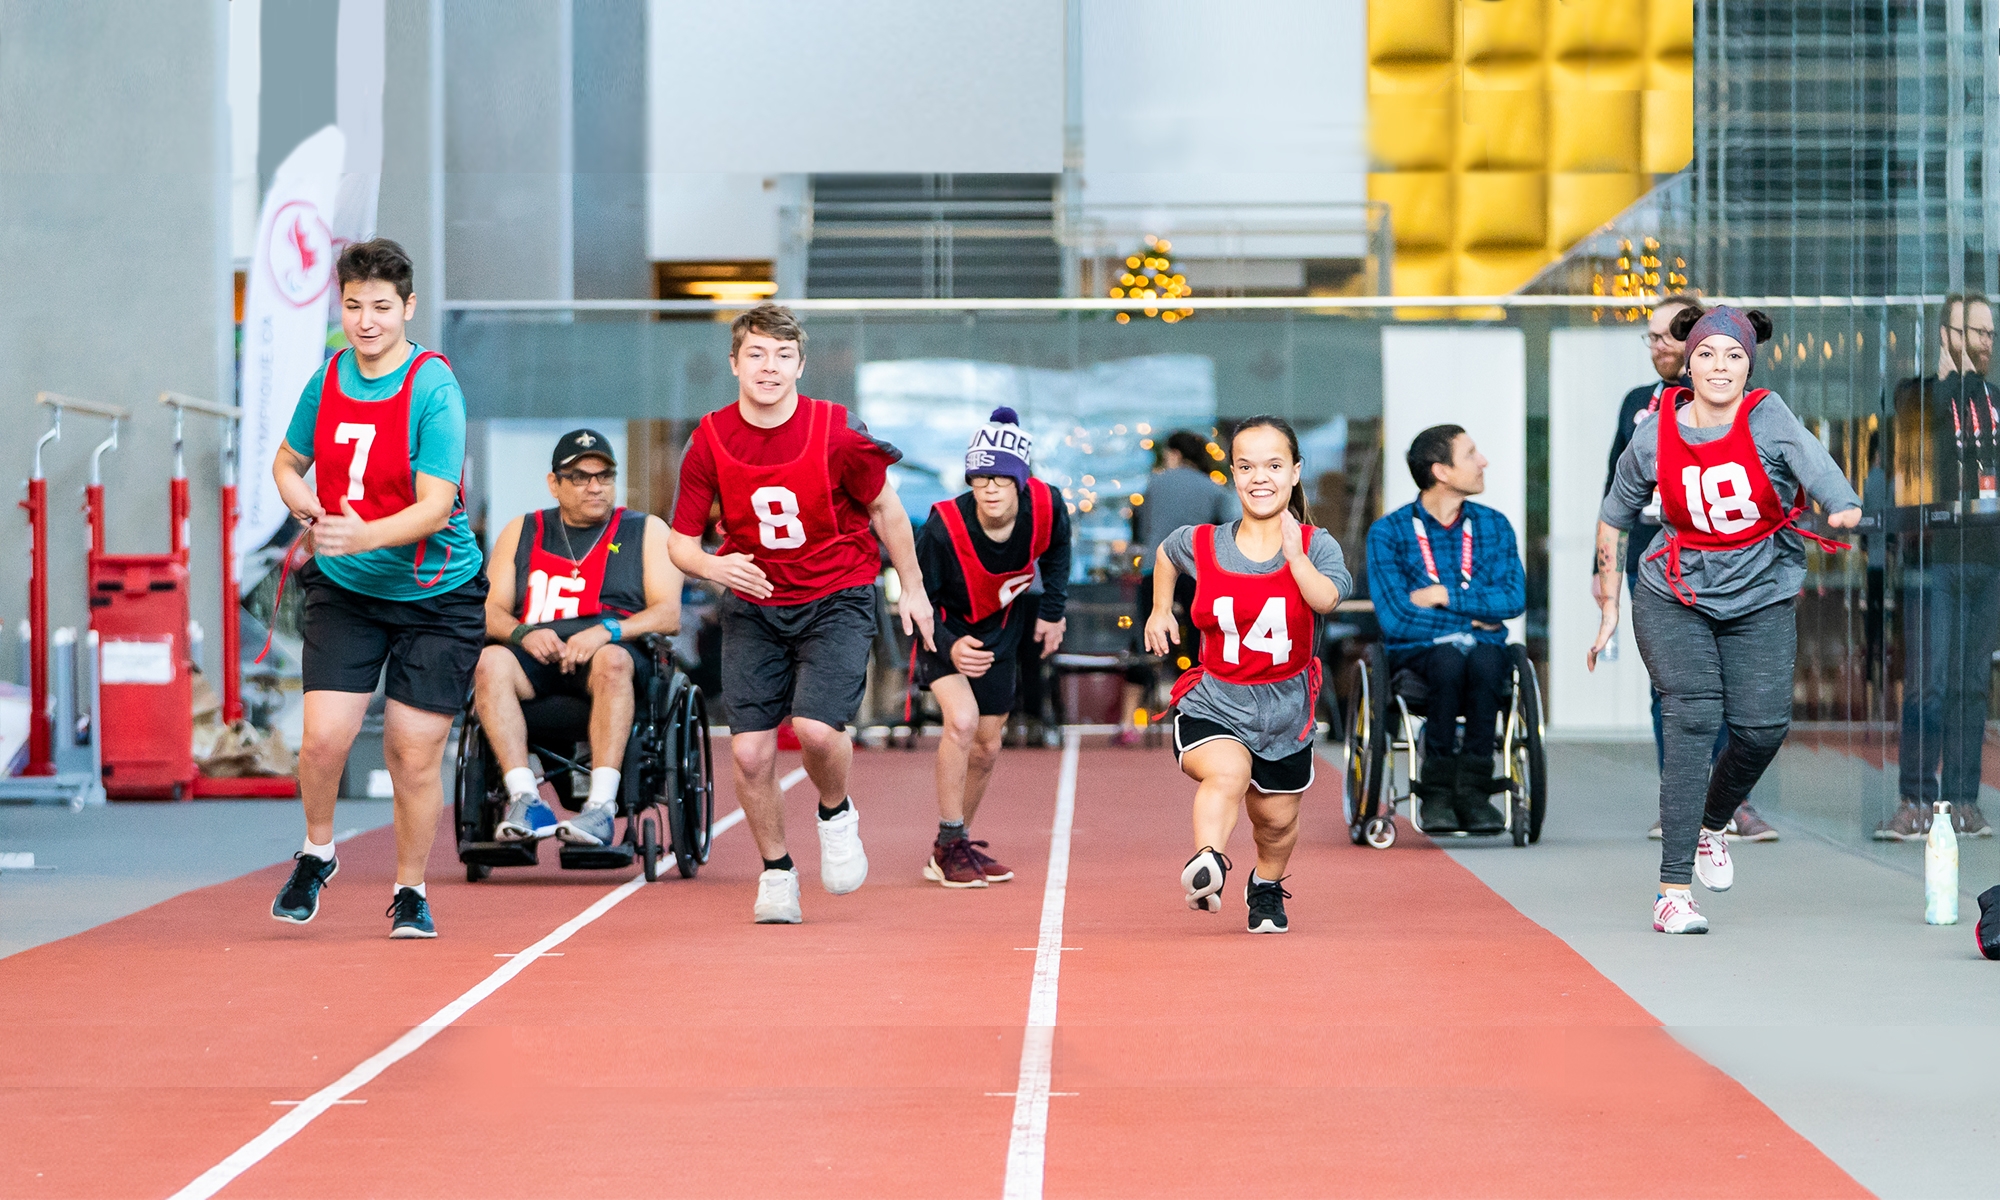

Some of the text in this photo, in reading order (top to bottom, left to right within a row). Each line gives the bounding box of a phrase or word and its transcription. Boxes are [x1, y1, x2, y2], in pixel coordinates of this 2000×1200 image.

[334, 422, 377, 501] 7
[750, 486, 807, 550] 8
[1681, 461, 1761, 535] 18
[525, 569, 586, 626] 16
[1212, 595, 1293, 666] 14
